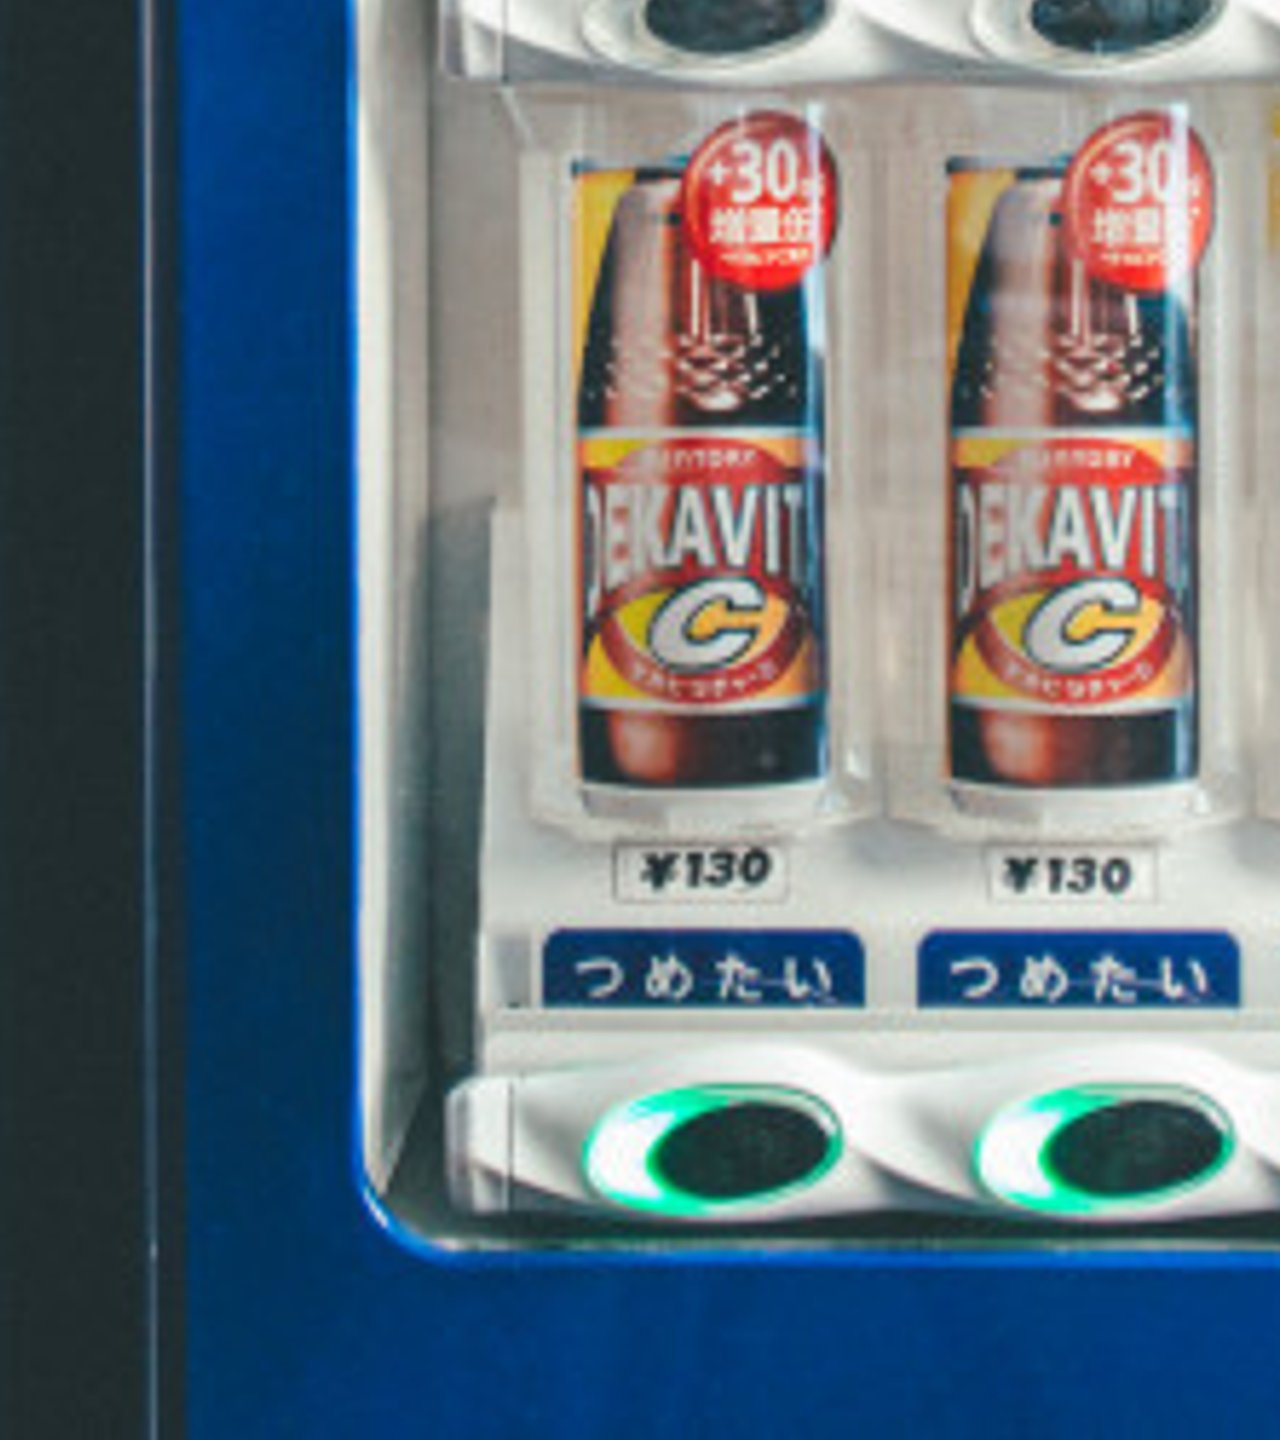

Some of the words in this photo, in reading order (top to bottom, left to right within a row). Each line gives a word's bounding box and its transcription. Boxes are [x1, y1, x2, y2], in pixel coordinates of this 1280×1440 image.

[646, 573, 767, 673] C
[1023, 573, 1141, 673] C
[640, 849, 773, 888] ¥130
[1004, 857, 1133, 893] ¥130
[576, 953, 834, 1001] つめたい
[950, 954, 1210, 1001] つめたい
